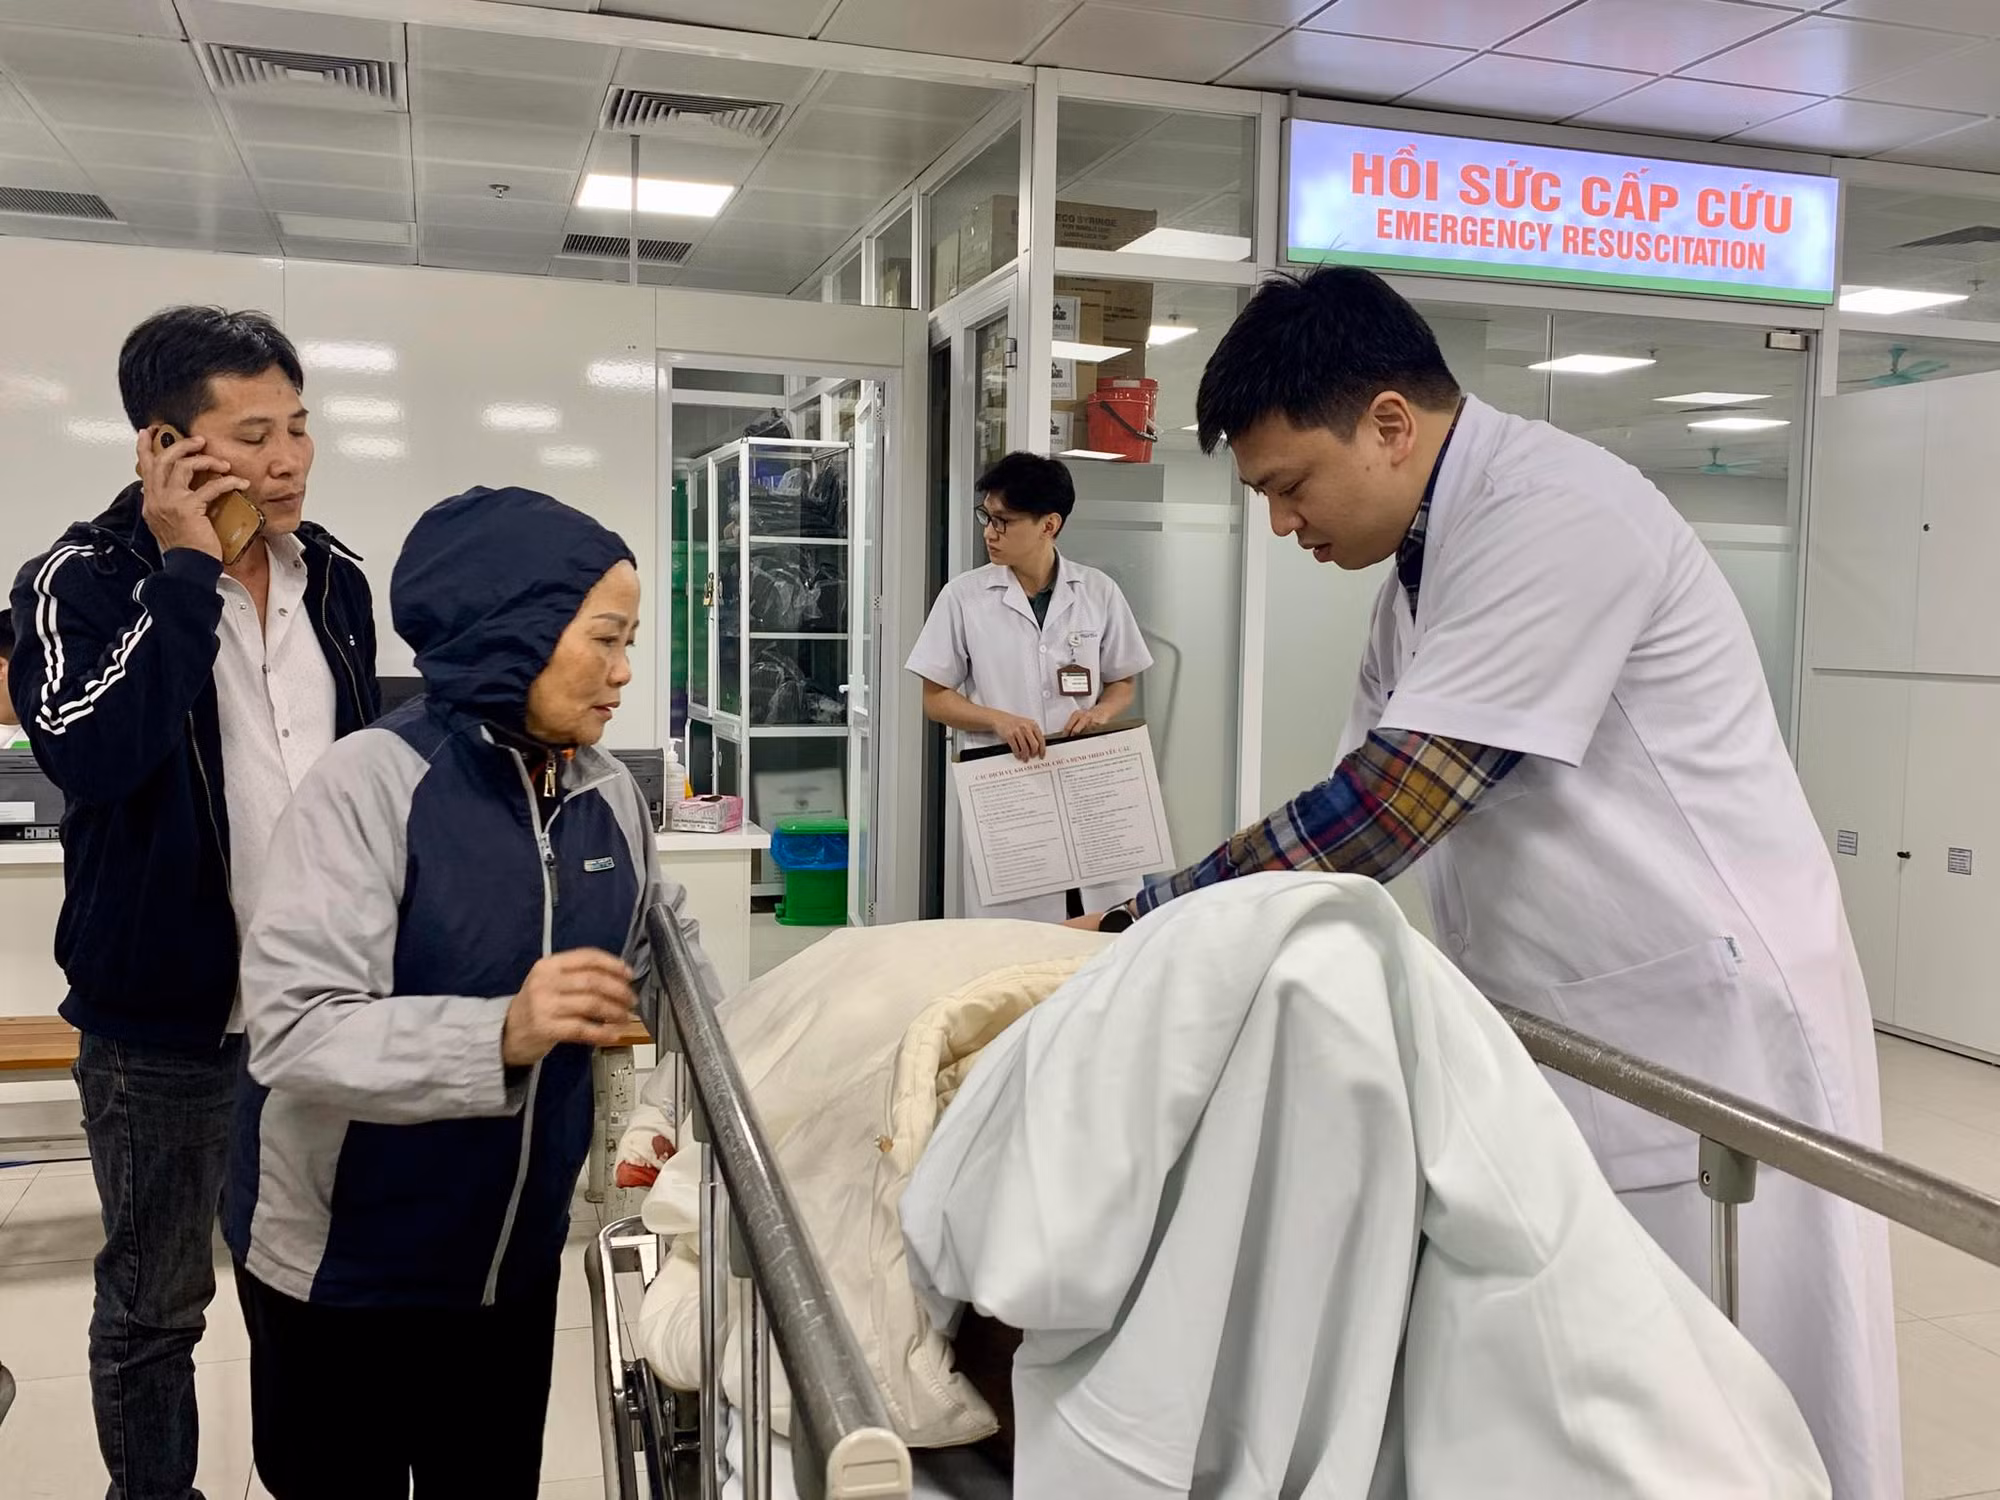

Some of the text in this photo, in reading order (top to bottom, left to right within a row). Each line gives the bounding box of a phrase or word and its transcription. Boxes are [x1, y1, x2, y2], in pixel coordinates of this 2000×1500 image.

[1351, 144, 1793, 235] HỒI SỨC CẤP CỨU
[1377, 208, 1765, 272] EMERGENCY RESUSCITATION
